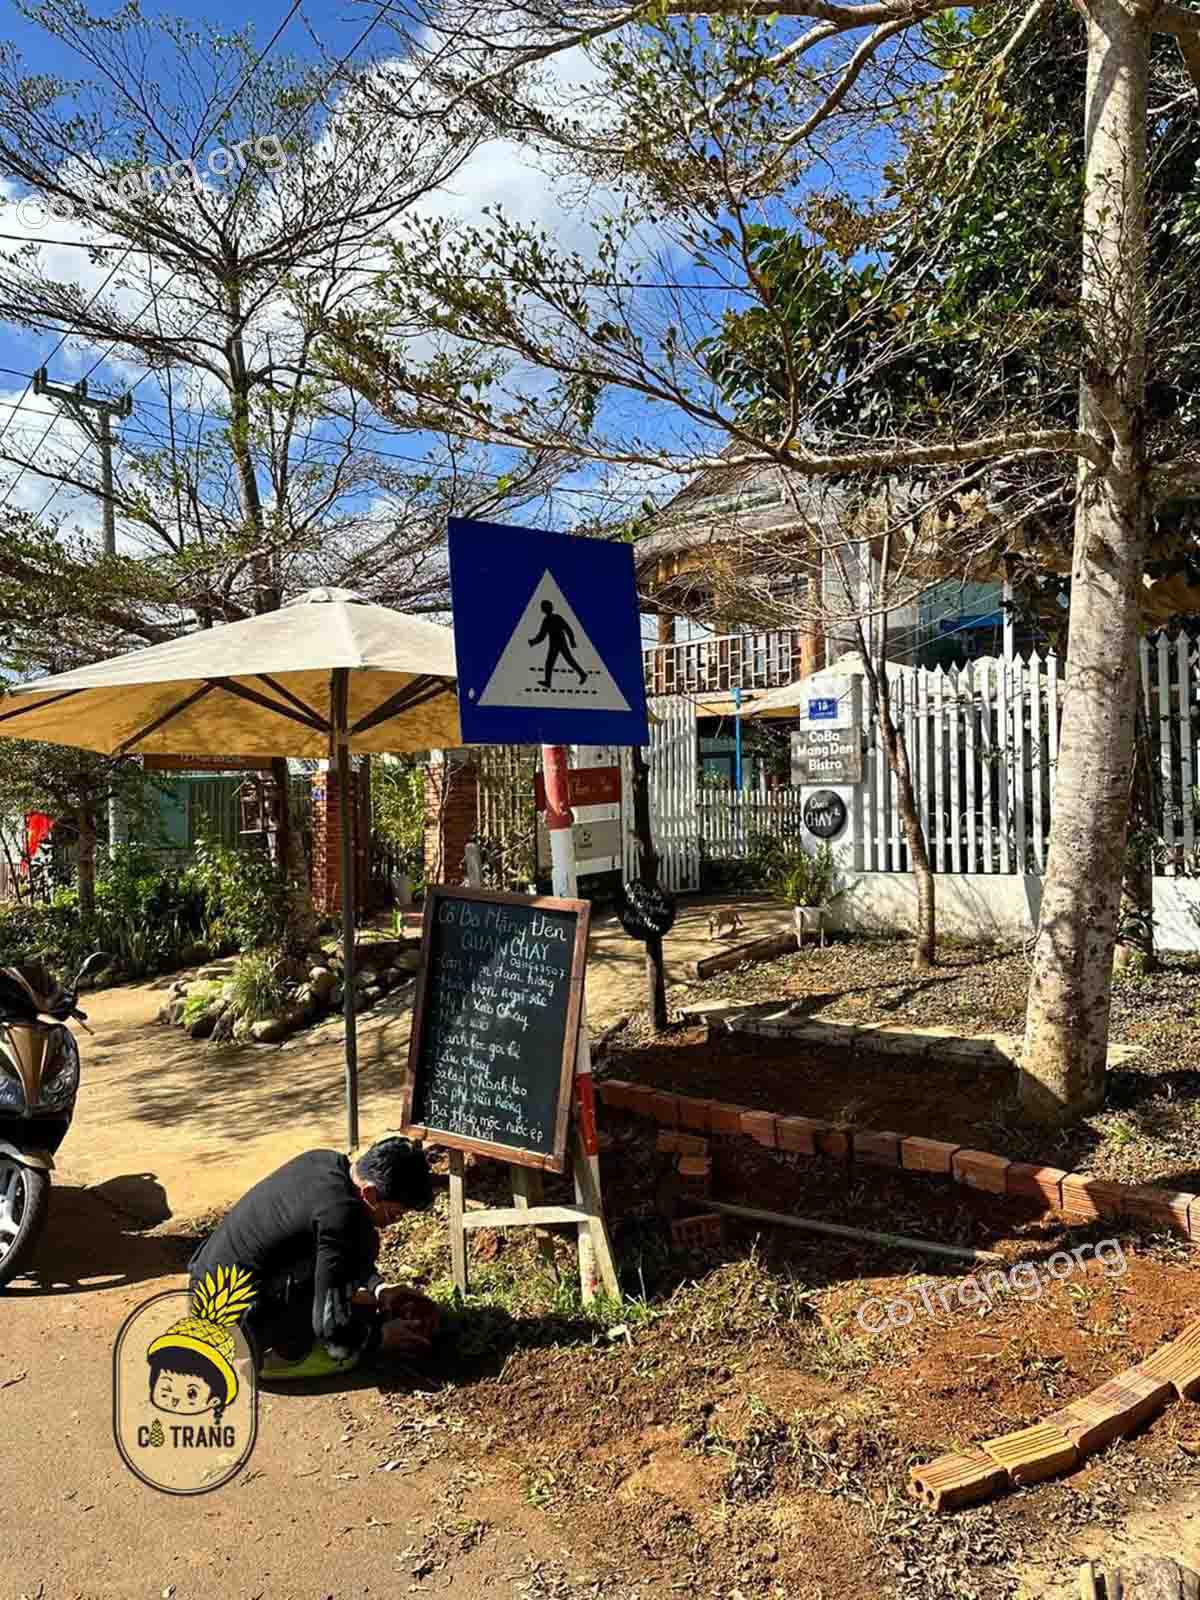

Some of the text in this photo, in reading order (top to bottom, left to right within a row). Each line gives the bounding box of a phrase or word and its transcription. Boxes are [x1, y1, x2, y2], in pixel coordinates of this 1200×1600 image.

[808, 730, 840, 743] CoBa
[830, 743, 854, 755] Den
[808, 759, 843, 771] Bistro
[510, 936, 550, 961] CHAY
